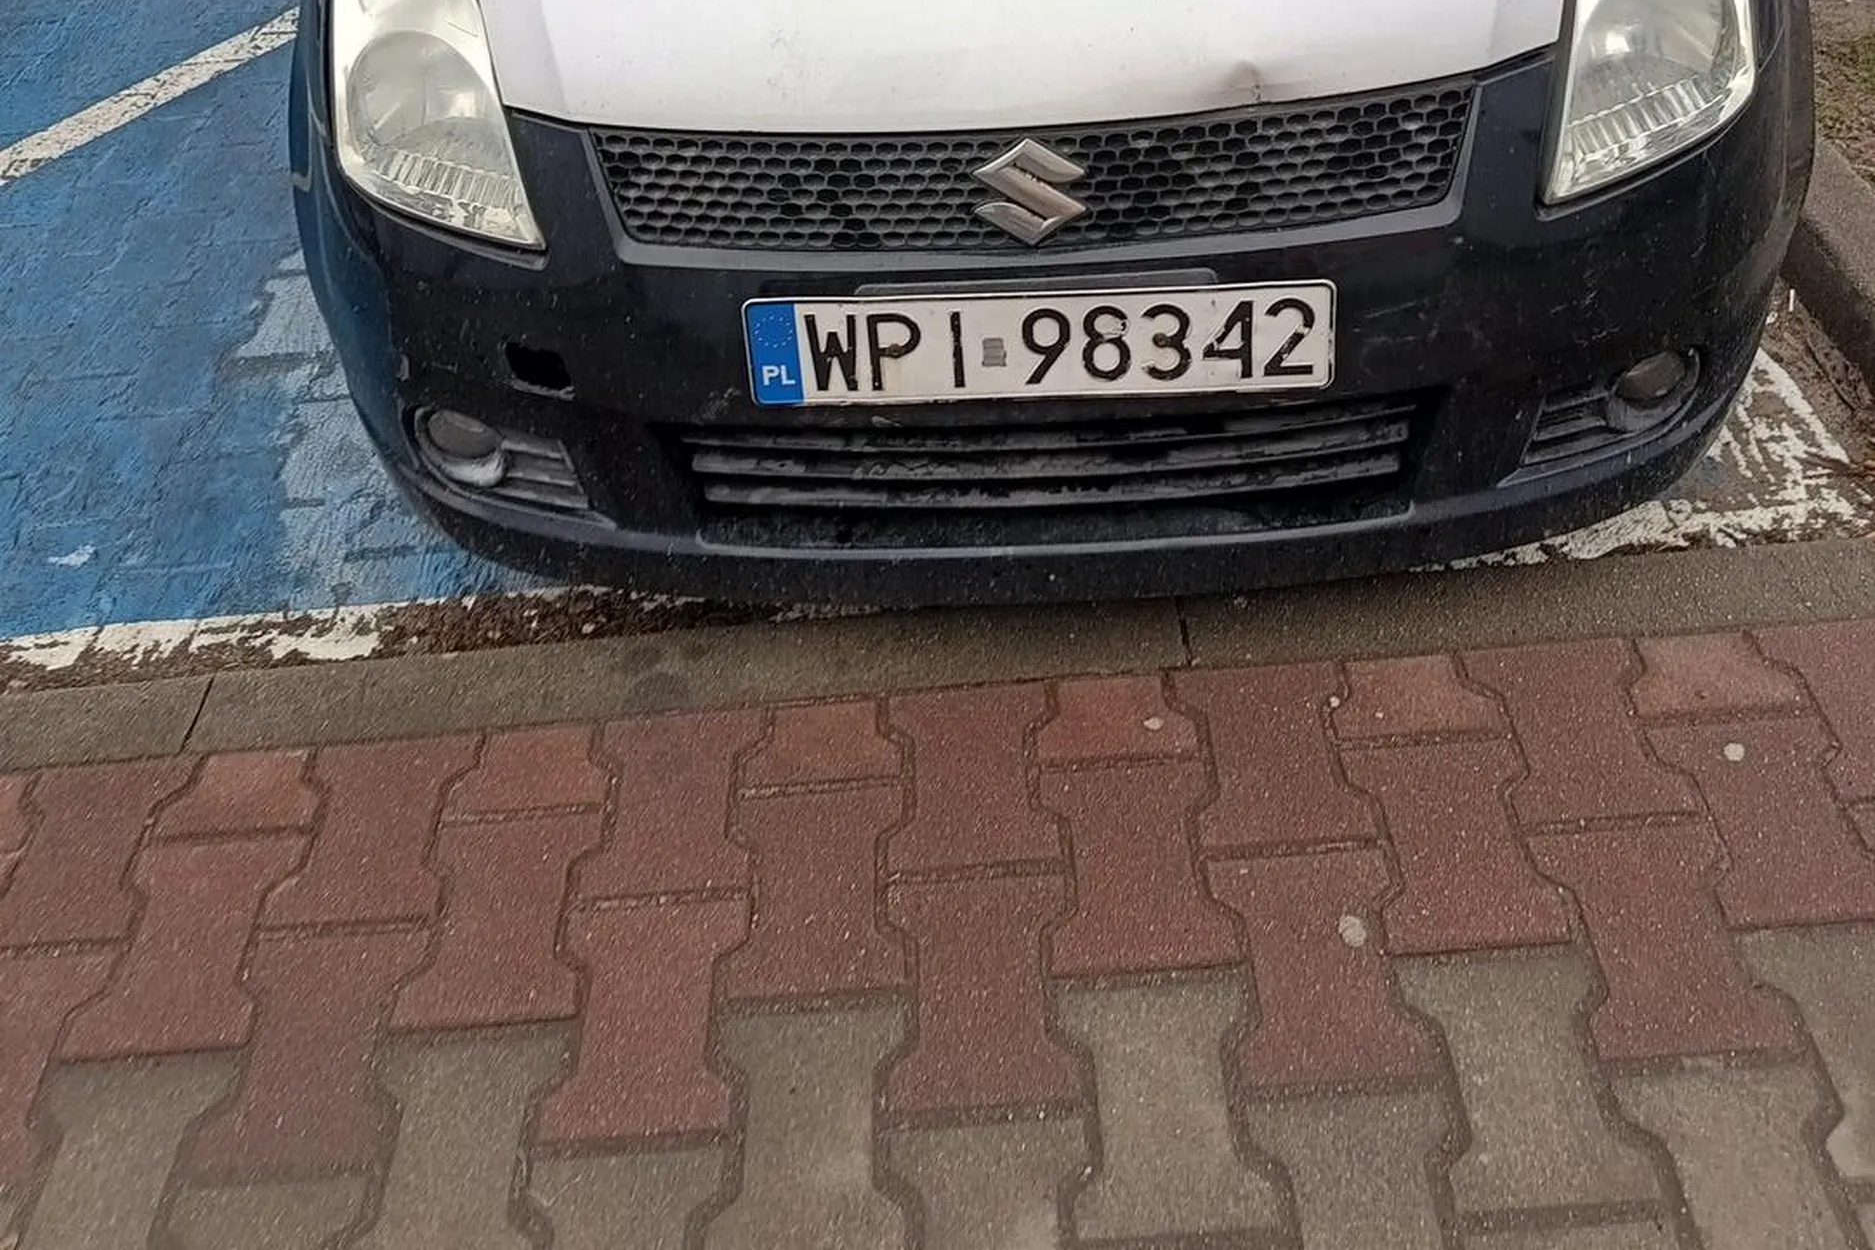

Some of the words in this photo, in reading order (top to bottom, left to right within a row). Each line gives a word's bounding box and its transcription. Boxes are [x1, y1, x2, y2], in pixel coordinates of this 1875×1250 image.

[804, 312, 967, 392] WPI
[1021, 297, 1316, 385] 98342
[762, 364, 796, 386] PL
